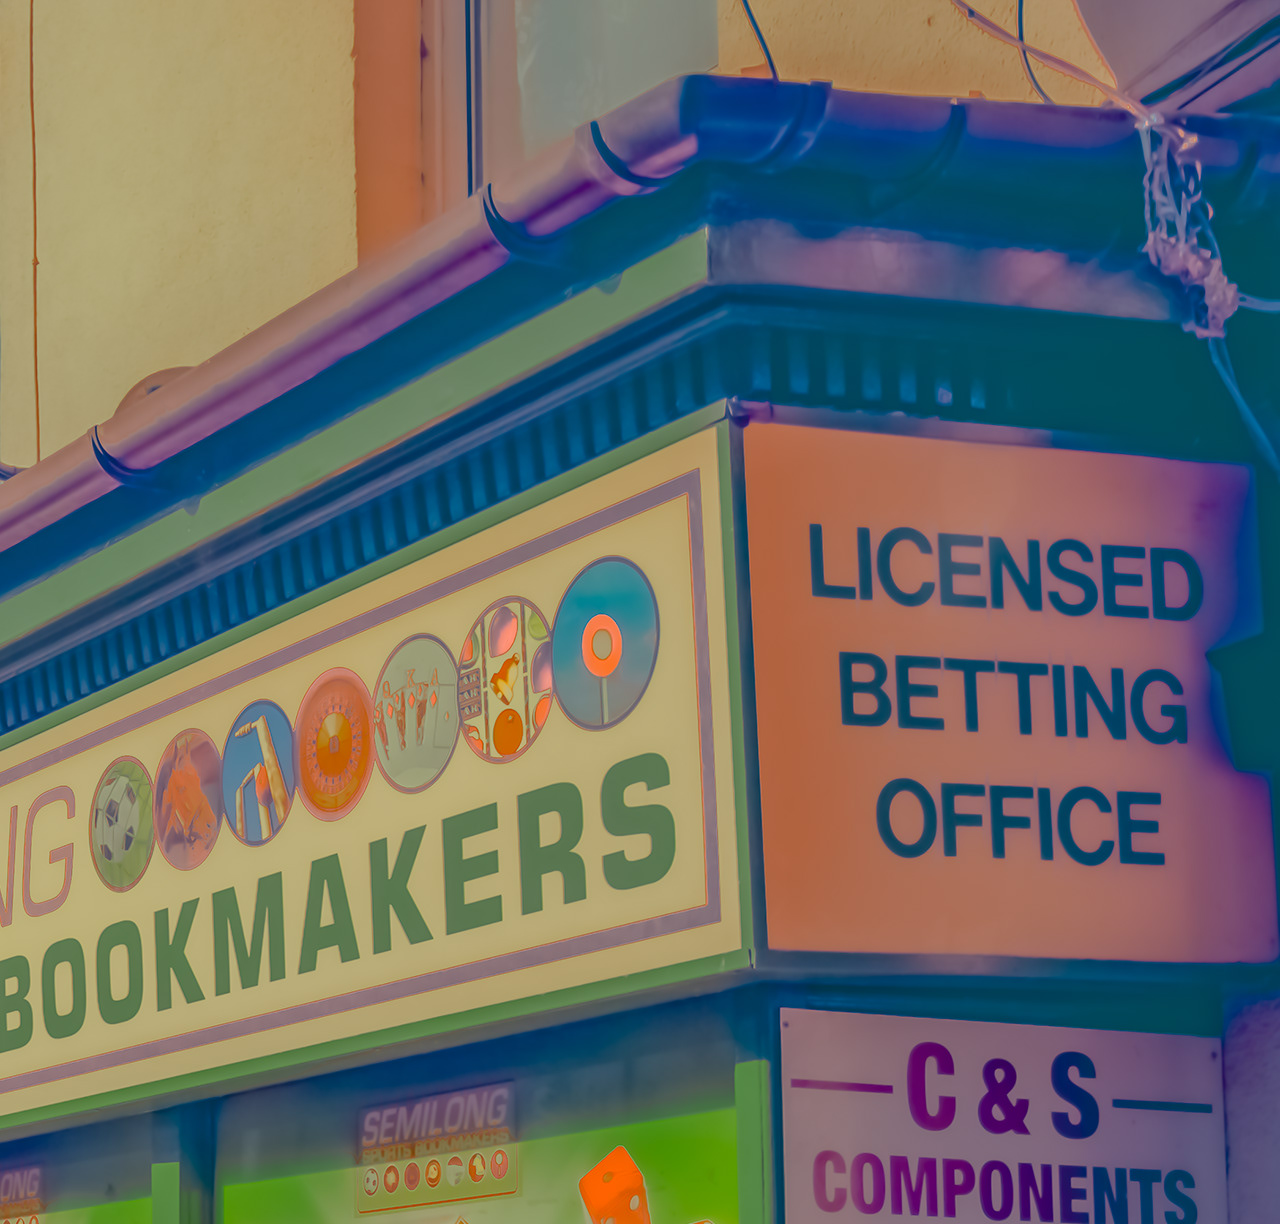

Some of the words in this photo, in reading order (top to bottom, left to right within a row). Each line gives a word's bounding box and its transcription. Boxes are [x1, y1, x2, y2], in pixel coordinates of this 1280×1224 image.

[809, 523, 1204, 622] LICENSED
[839, 651, 1188, 745] BETTING
[876, 777, 1165, 866] OFFICE
[361, 1087, 509, 1148] SEMILONG
[907, 1042, 956, 1131] C
[978, 1058, 1030, 1135] &
[1050, 1051, 1100, 1139] S
